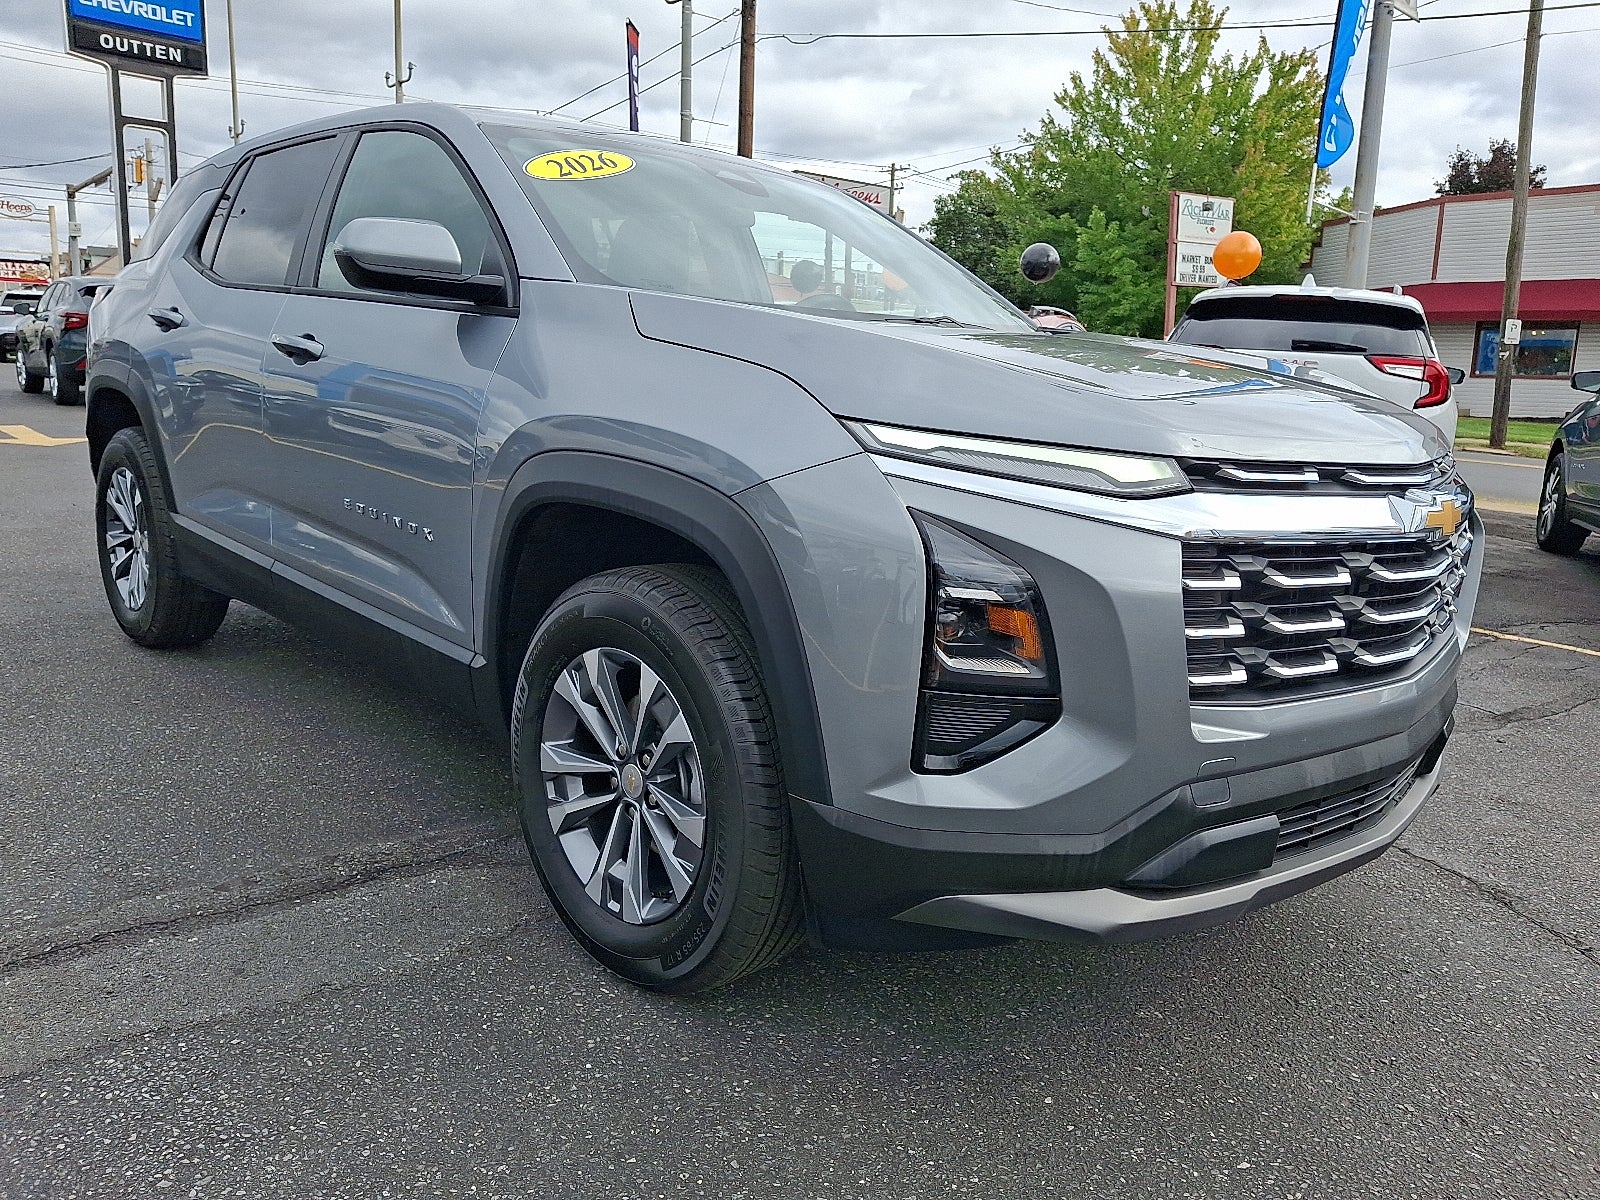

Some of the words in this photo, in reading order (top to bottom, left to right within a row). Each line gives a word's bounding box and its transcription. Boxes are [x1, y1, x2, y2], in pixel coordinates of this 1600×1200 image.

[100, 33, 182, 62] OUTTEN
[546, 152, 618, 177] 2026
[343, 498, 434, 542] EQUINOX
